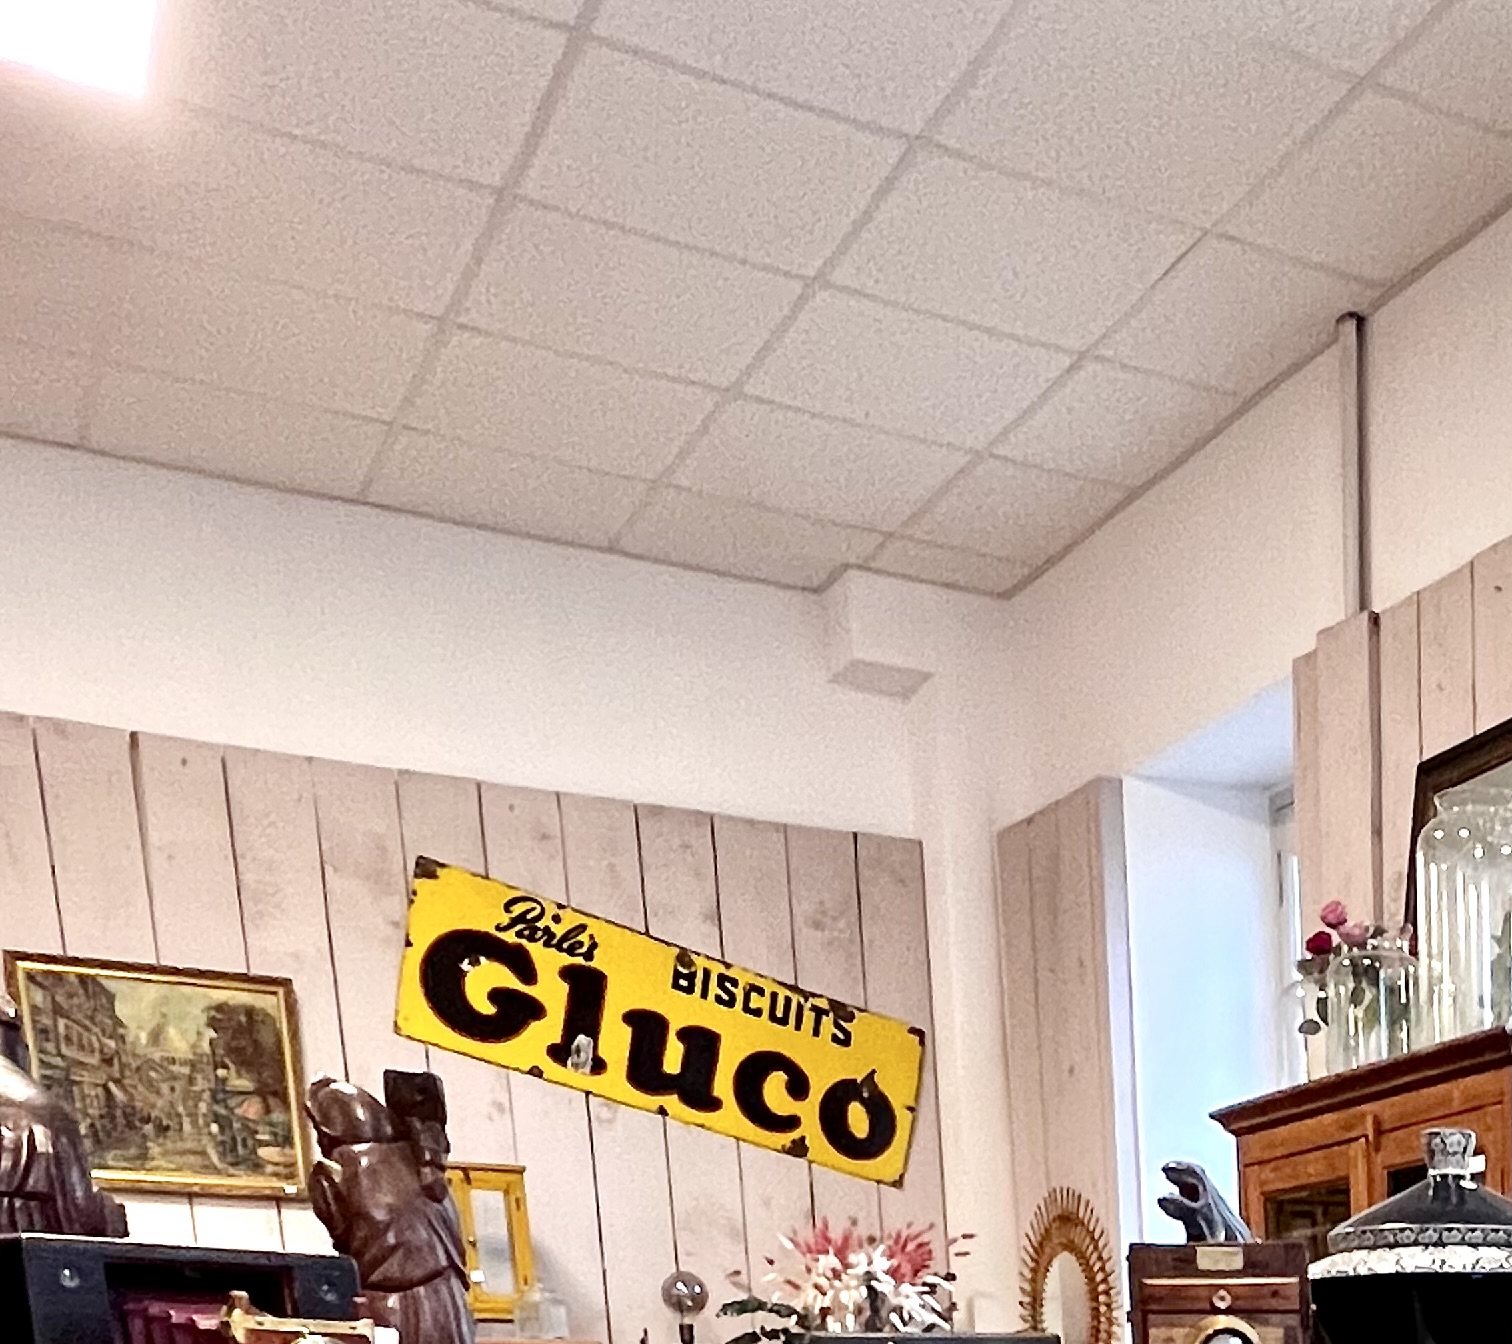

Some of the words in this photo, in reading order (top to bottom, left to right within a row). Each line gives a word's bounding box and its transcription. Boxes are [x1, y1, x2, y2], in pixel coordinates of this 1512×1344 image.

[495, 896, 598, 962] Parle's
[419, 929, 898, 1160] Gluco
[671, 957, 853, 1047] BISCUITS
